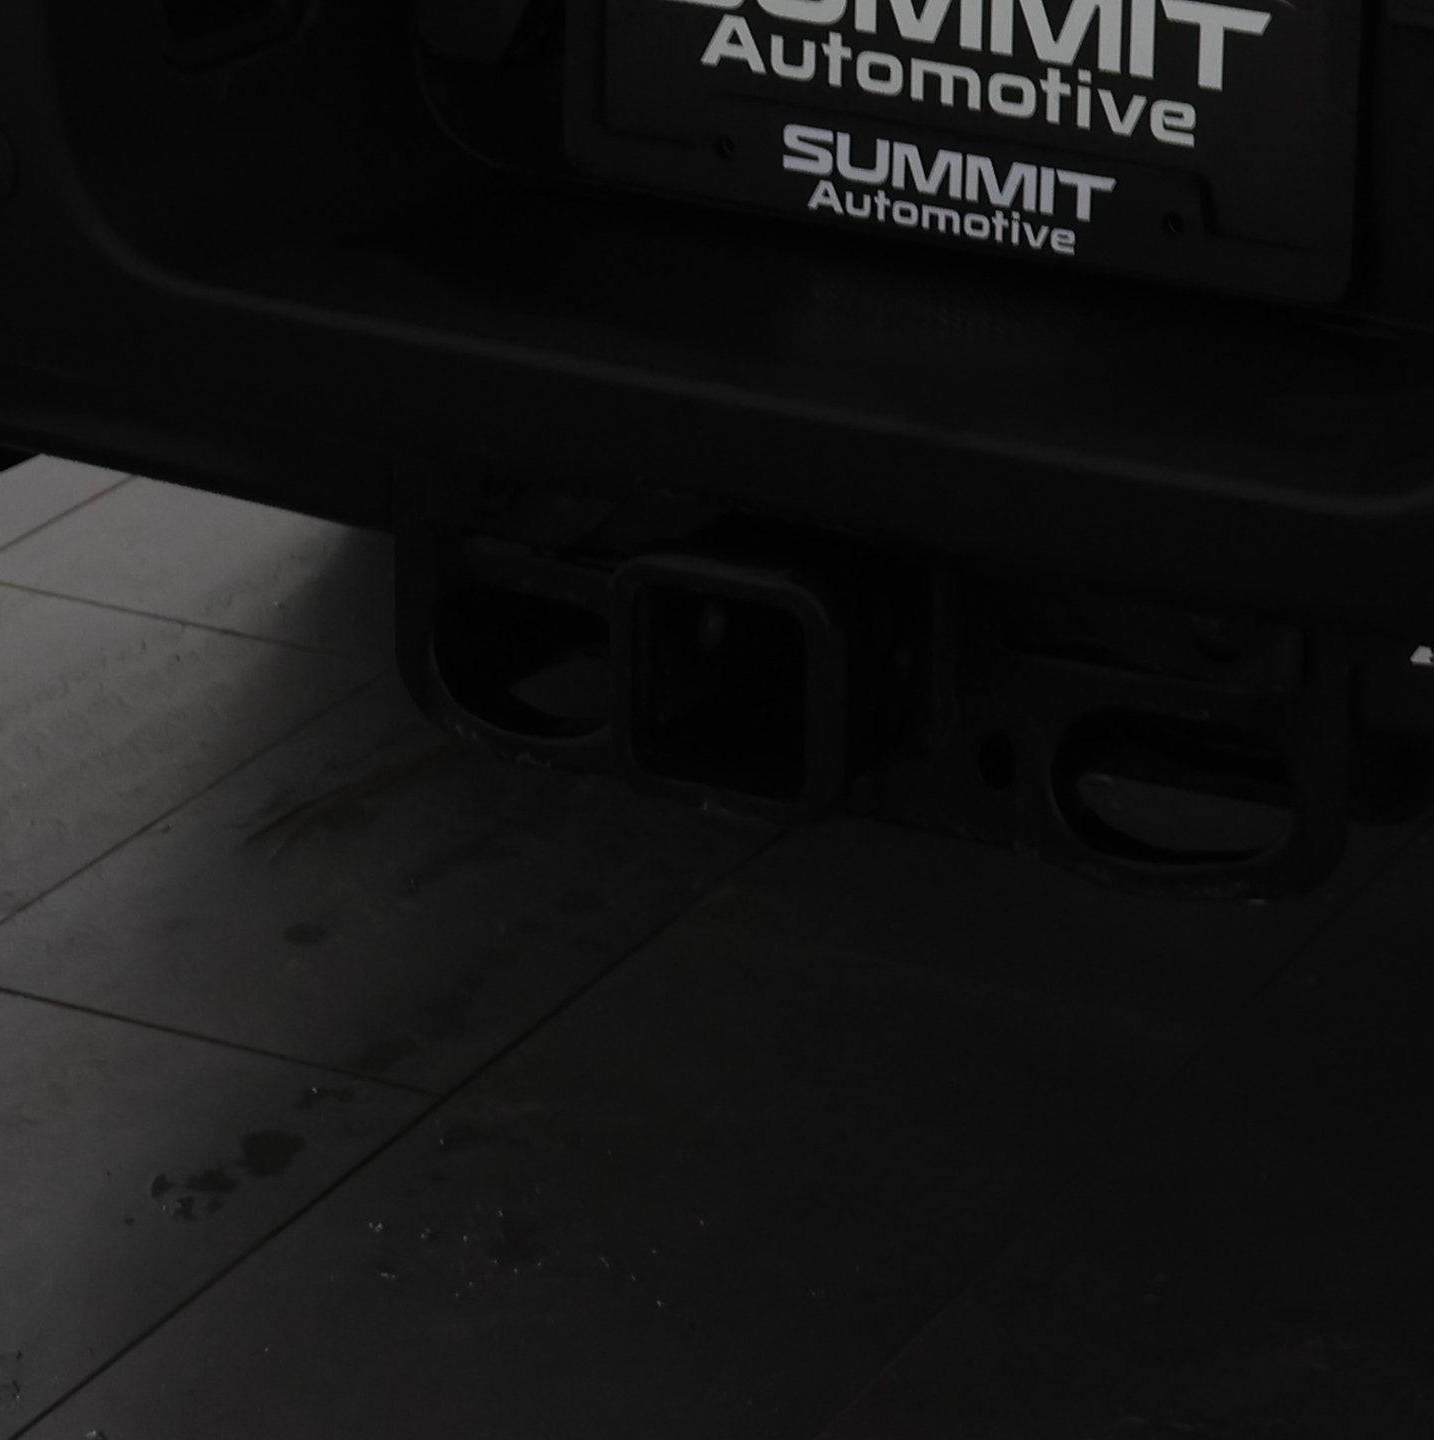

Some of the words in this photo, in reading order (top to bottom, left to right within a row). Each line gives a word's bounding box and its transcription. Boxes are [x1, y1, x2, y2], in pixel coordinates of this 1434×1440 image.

[701, 14, 1197, 148] Automotive
[782, 123, 1117, 222] SUMMIT
[807, 179, 1077, 256] Automotive
